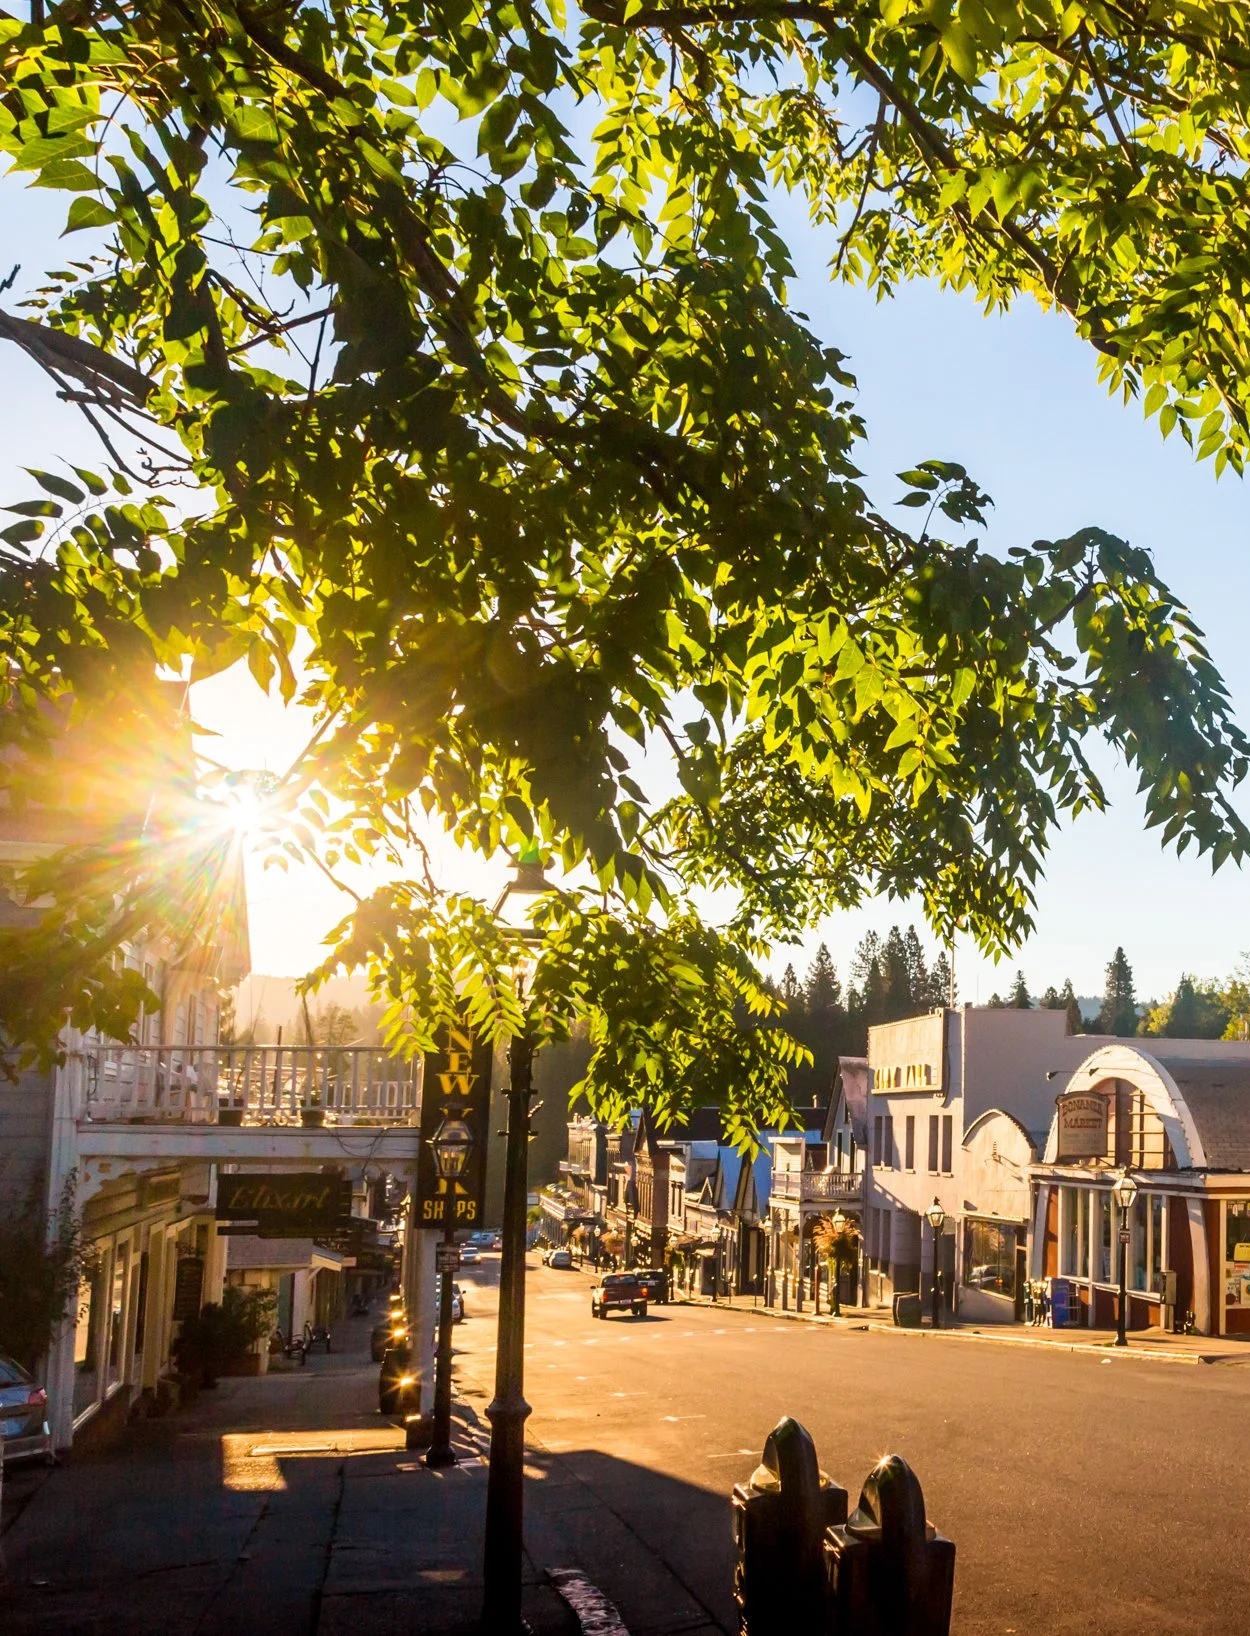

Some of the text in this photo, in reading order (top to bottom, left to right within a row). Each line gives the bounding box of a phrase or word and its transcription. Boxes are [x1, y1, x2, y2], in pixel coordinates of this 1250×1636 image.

[435, 1026, 480, 1096] NEW
[1063, 1117, 1103, 1129] MARKET
[423, 1200, 476, 1220] SHPS
